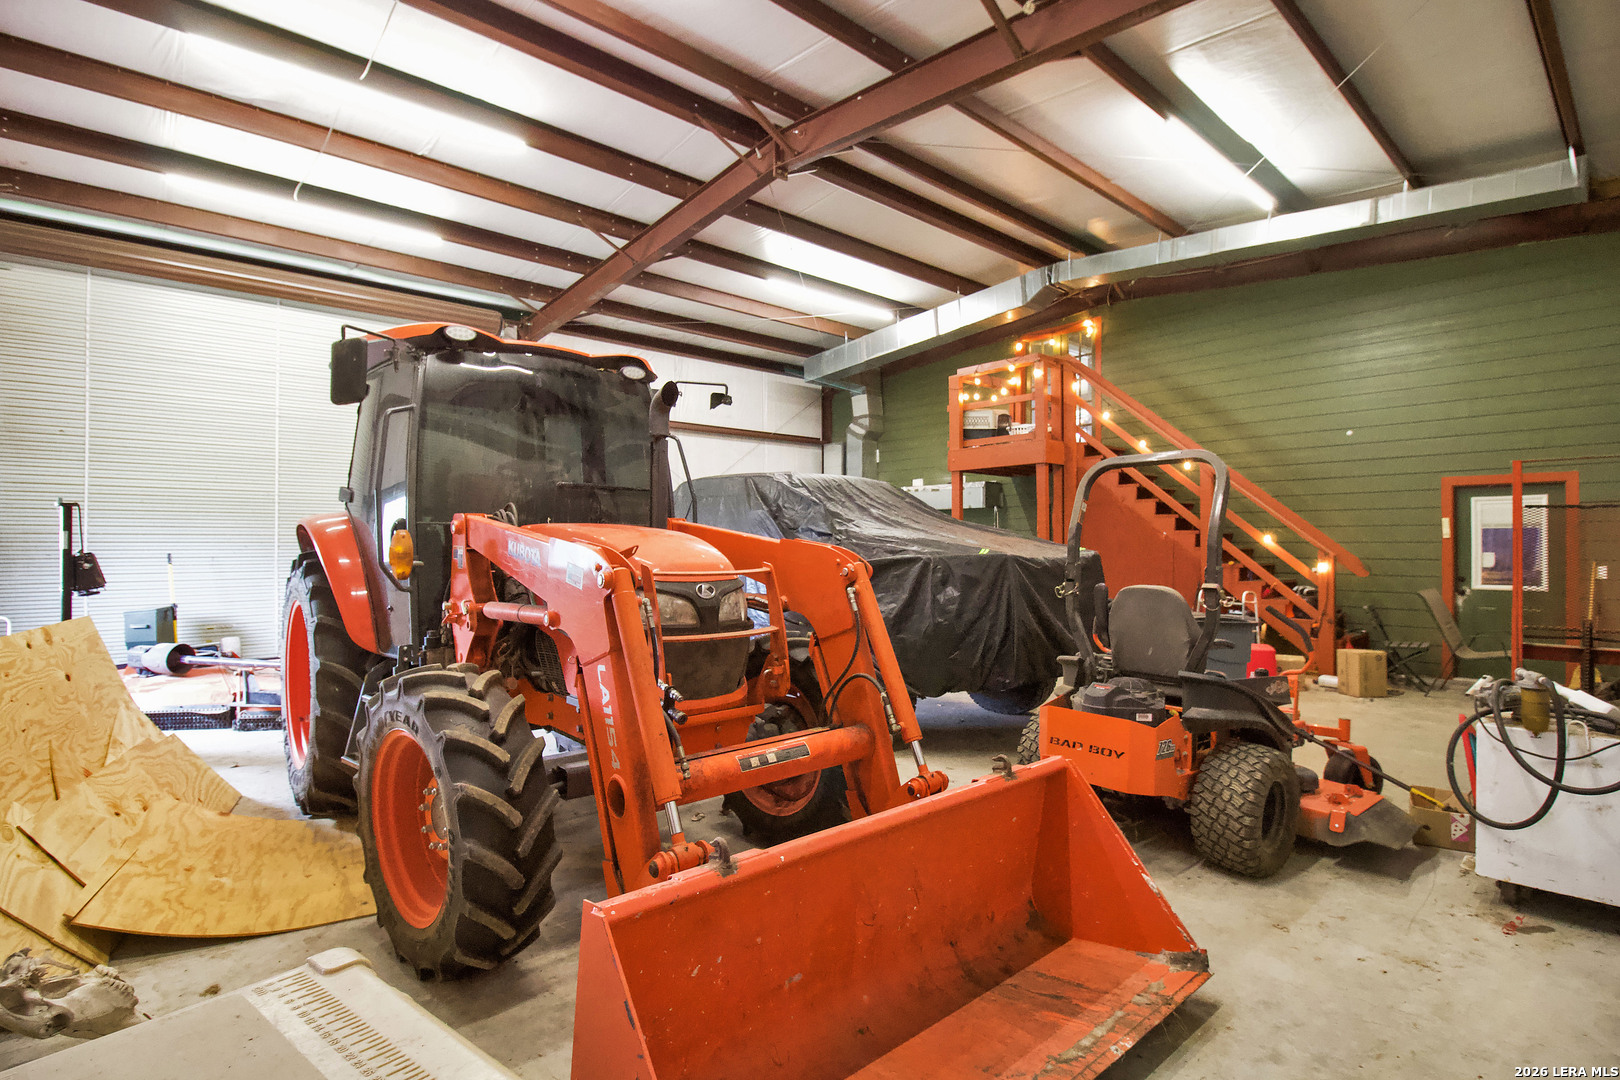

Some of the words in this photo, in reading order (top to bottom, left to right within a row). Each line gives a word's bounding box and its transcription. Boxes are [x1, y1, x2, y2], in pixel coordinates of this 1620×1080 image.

[507, 540, 541, 568] KUBOTA
[597, 664, 621, 770] LA1154
[1049, 736, 1083, 751] BAD
[1088, 744, 1125, 759] BOY
